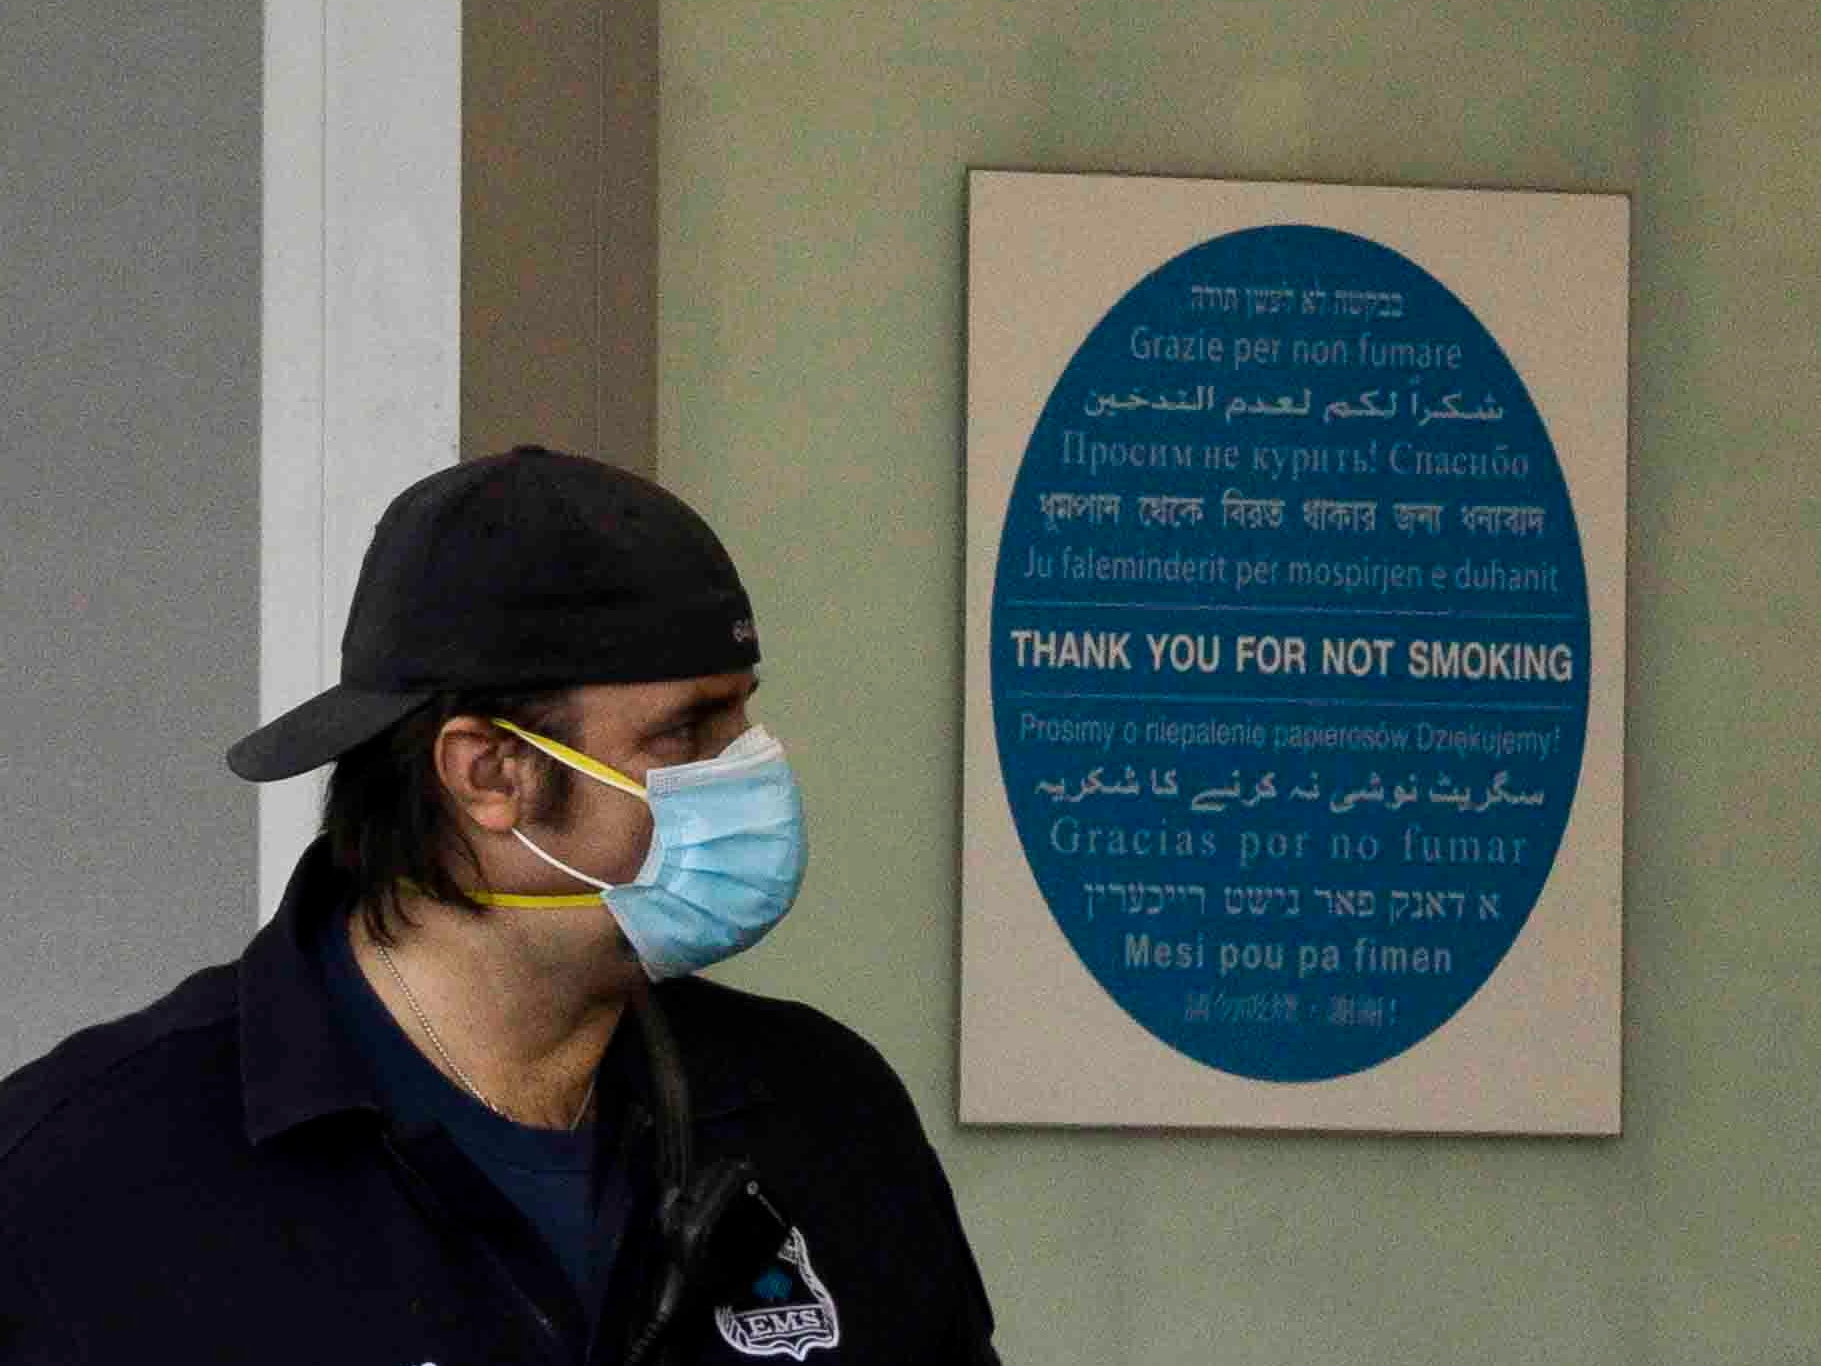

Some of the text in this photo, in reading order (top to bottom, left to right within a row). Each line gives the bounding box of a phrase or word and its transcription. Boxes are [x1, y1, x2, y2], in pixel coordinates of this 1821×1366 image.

[1130, 324, 1463, 372] Grazie per non fumare
[1224, 387, 1312, 421] لعدم
[1323, 389, 1397, 424] لكم
[1061, 430, 1194, 476] Просим
[1203, 445, 1240, 473] не
[1389, 443, 1530, 477] Спасибо
[1023, 546, 1054, 579] Ju
[1061, 546, 1226, 584] faleminderit
[1429, 567, 1448, 587] e
[1454, 560, 1559, 593] duhanit
[1009, 629, 1574, 683] THANK YOU FOR NOT SMOKING
[1019, 713, 1116, 750] Prosimy
[1122, 722, 1138, 743] o
[1049, 815, 1528, 867] Gracias por no fumar
[1124, 934, 1453, 979] Mesi pou pa fimen
[743, 1309, 822, 1337] EMS
